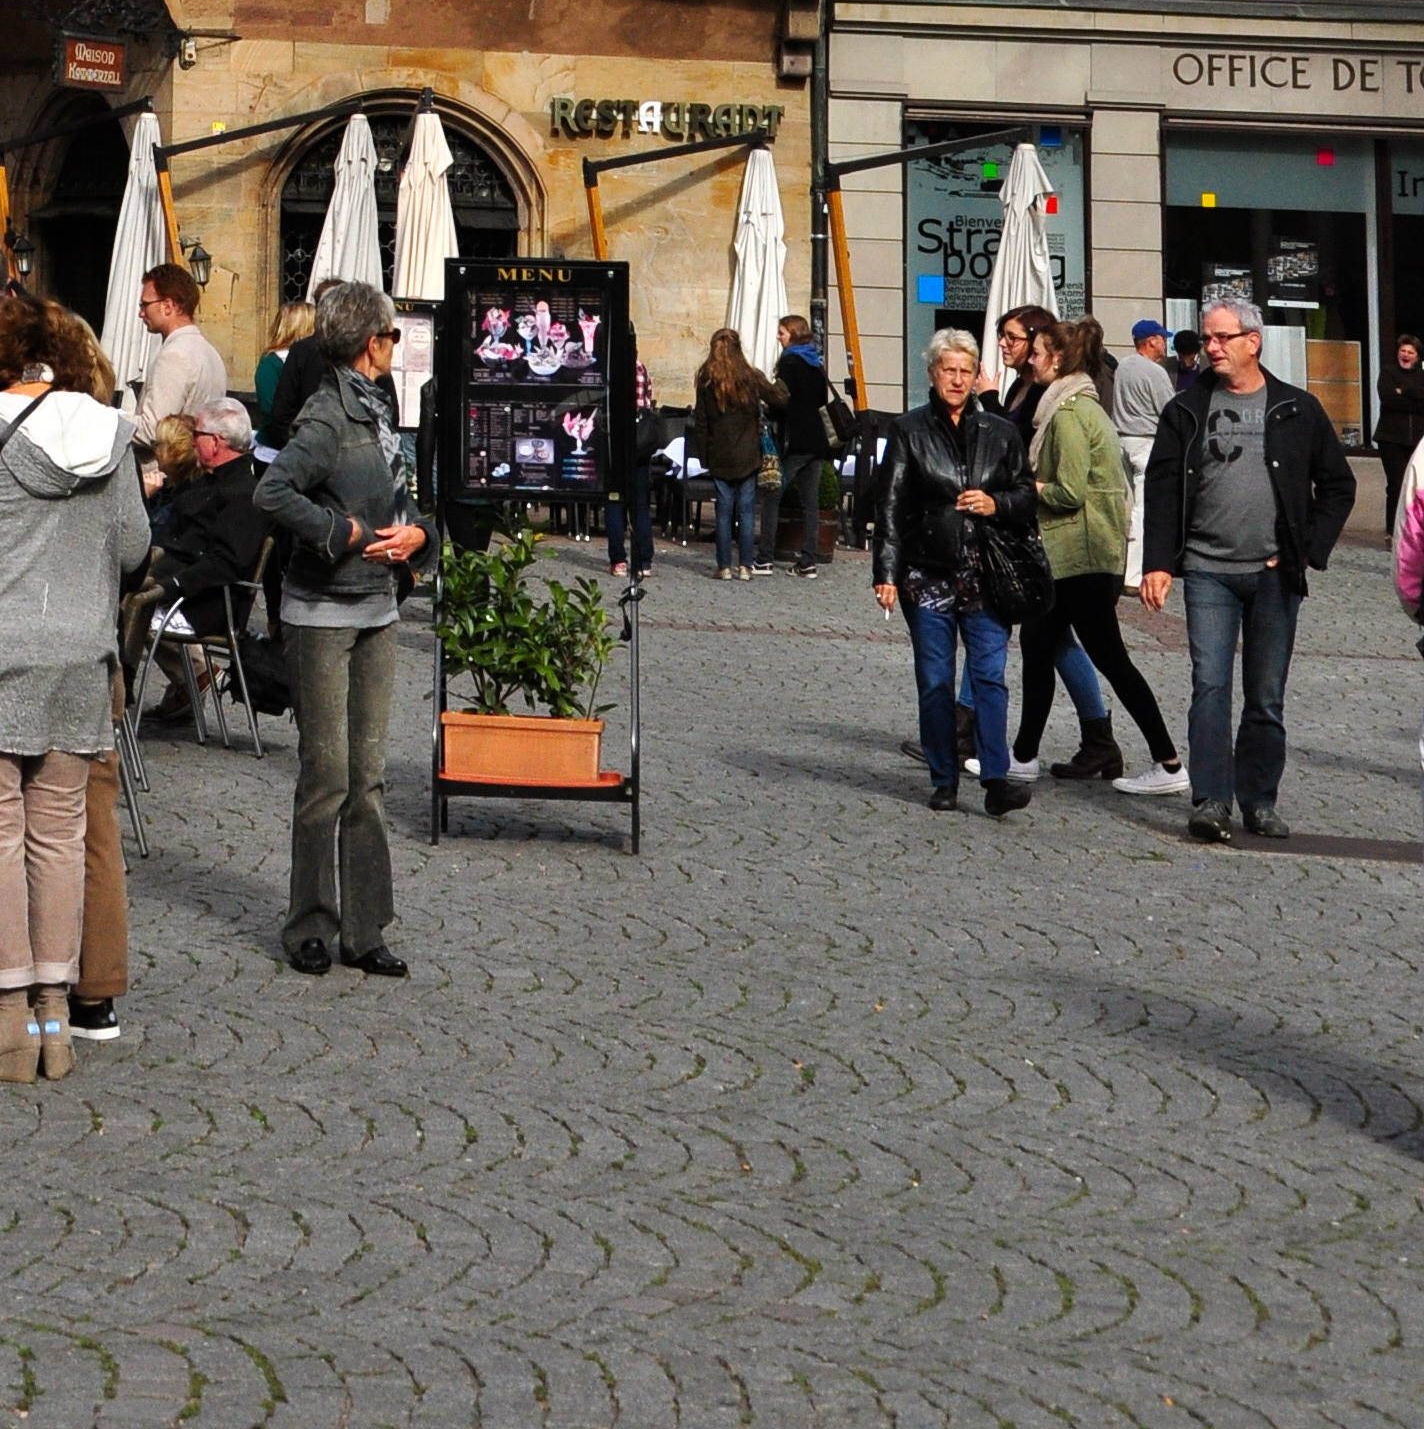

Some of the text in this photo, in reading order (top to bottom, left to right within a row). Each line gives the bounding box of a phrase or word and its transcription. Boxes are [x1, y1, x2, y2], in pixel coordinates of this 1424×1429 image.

[1173, 53, 1424, 93] OFFICE DE T
[497, 268, 572, 283] MENU
